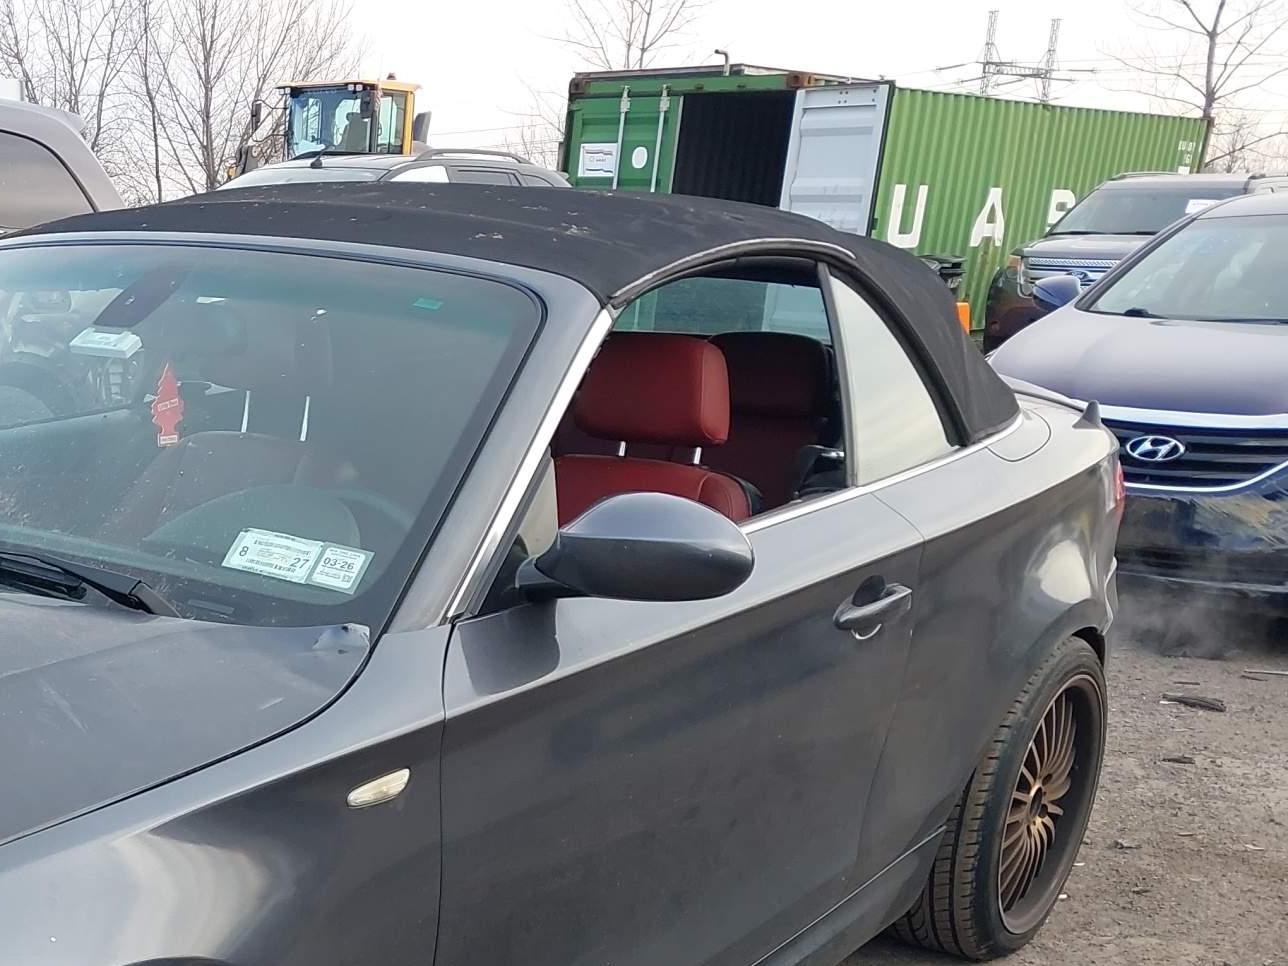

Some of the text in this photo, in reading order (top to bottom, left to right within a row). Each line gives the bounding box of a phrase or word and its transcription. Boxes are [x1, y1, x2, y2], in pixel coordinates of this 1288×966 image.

[239, 545, 249, 557] 8
[290, 557, 310, 570] 27
[323, 556, 355, 570] 03-26
